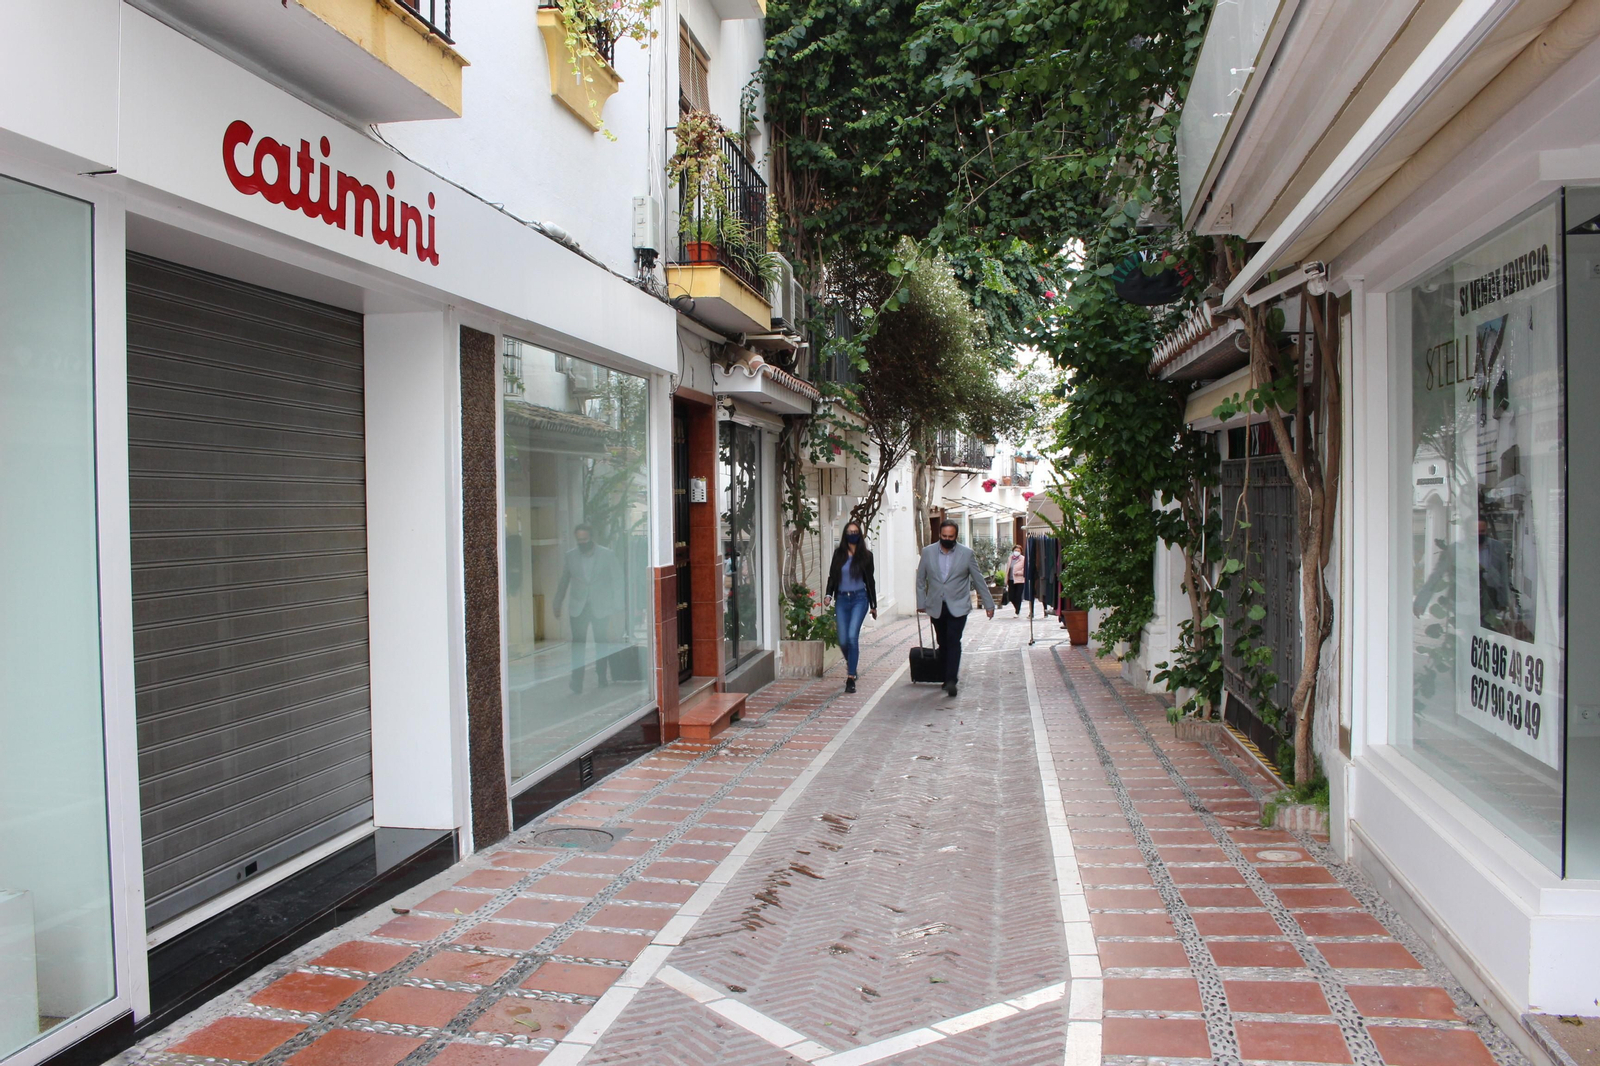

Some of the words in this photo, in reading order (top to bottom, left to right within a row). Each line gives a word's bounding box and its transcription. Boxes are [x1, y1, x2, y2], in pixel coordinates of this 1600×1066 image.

[223, 120, 439, 266] catimini
[1470, 268, 1501, 311] VENDE
[1503, 244, 1550, 298] EDIFICIO
[1471, 635, 1490, 673] 626
[1492, 643, 1507, 680] 96
[1509, 650, 1522, 687] 49
[1525, 655, 1544, 696] 39
[1471, 675, 1490, 712] 627
[1491, 683, 1505, 721] 90
[1507, 691, 1522, 730] 33
[1525, 699, 1541, 740] 49
